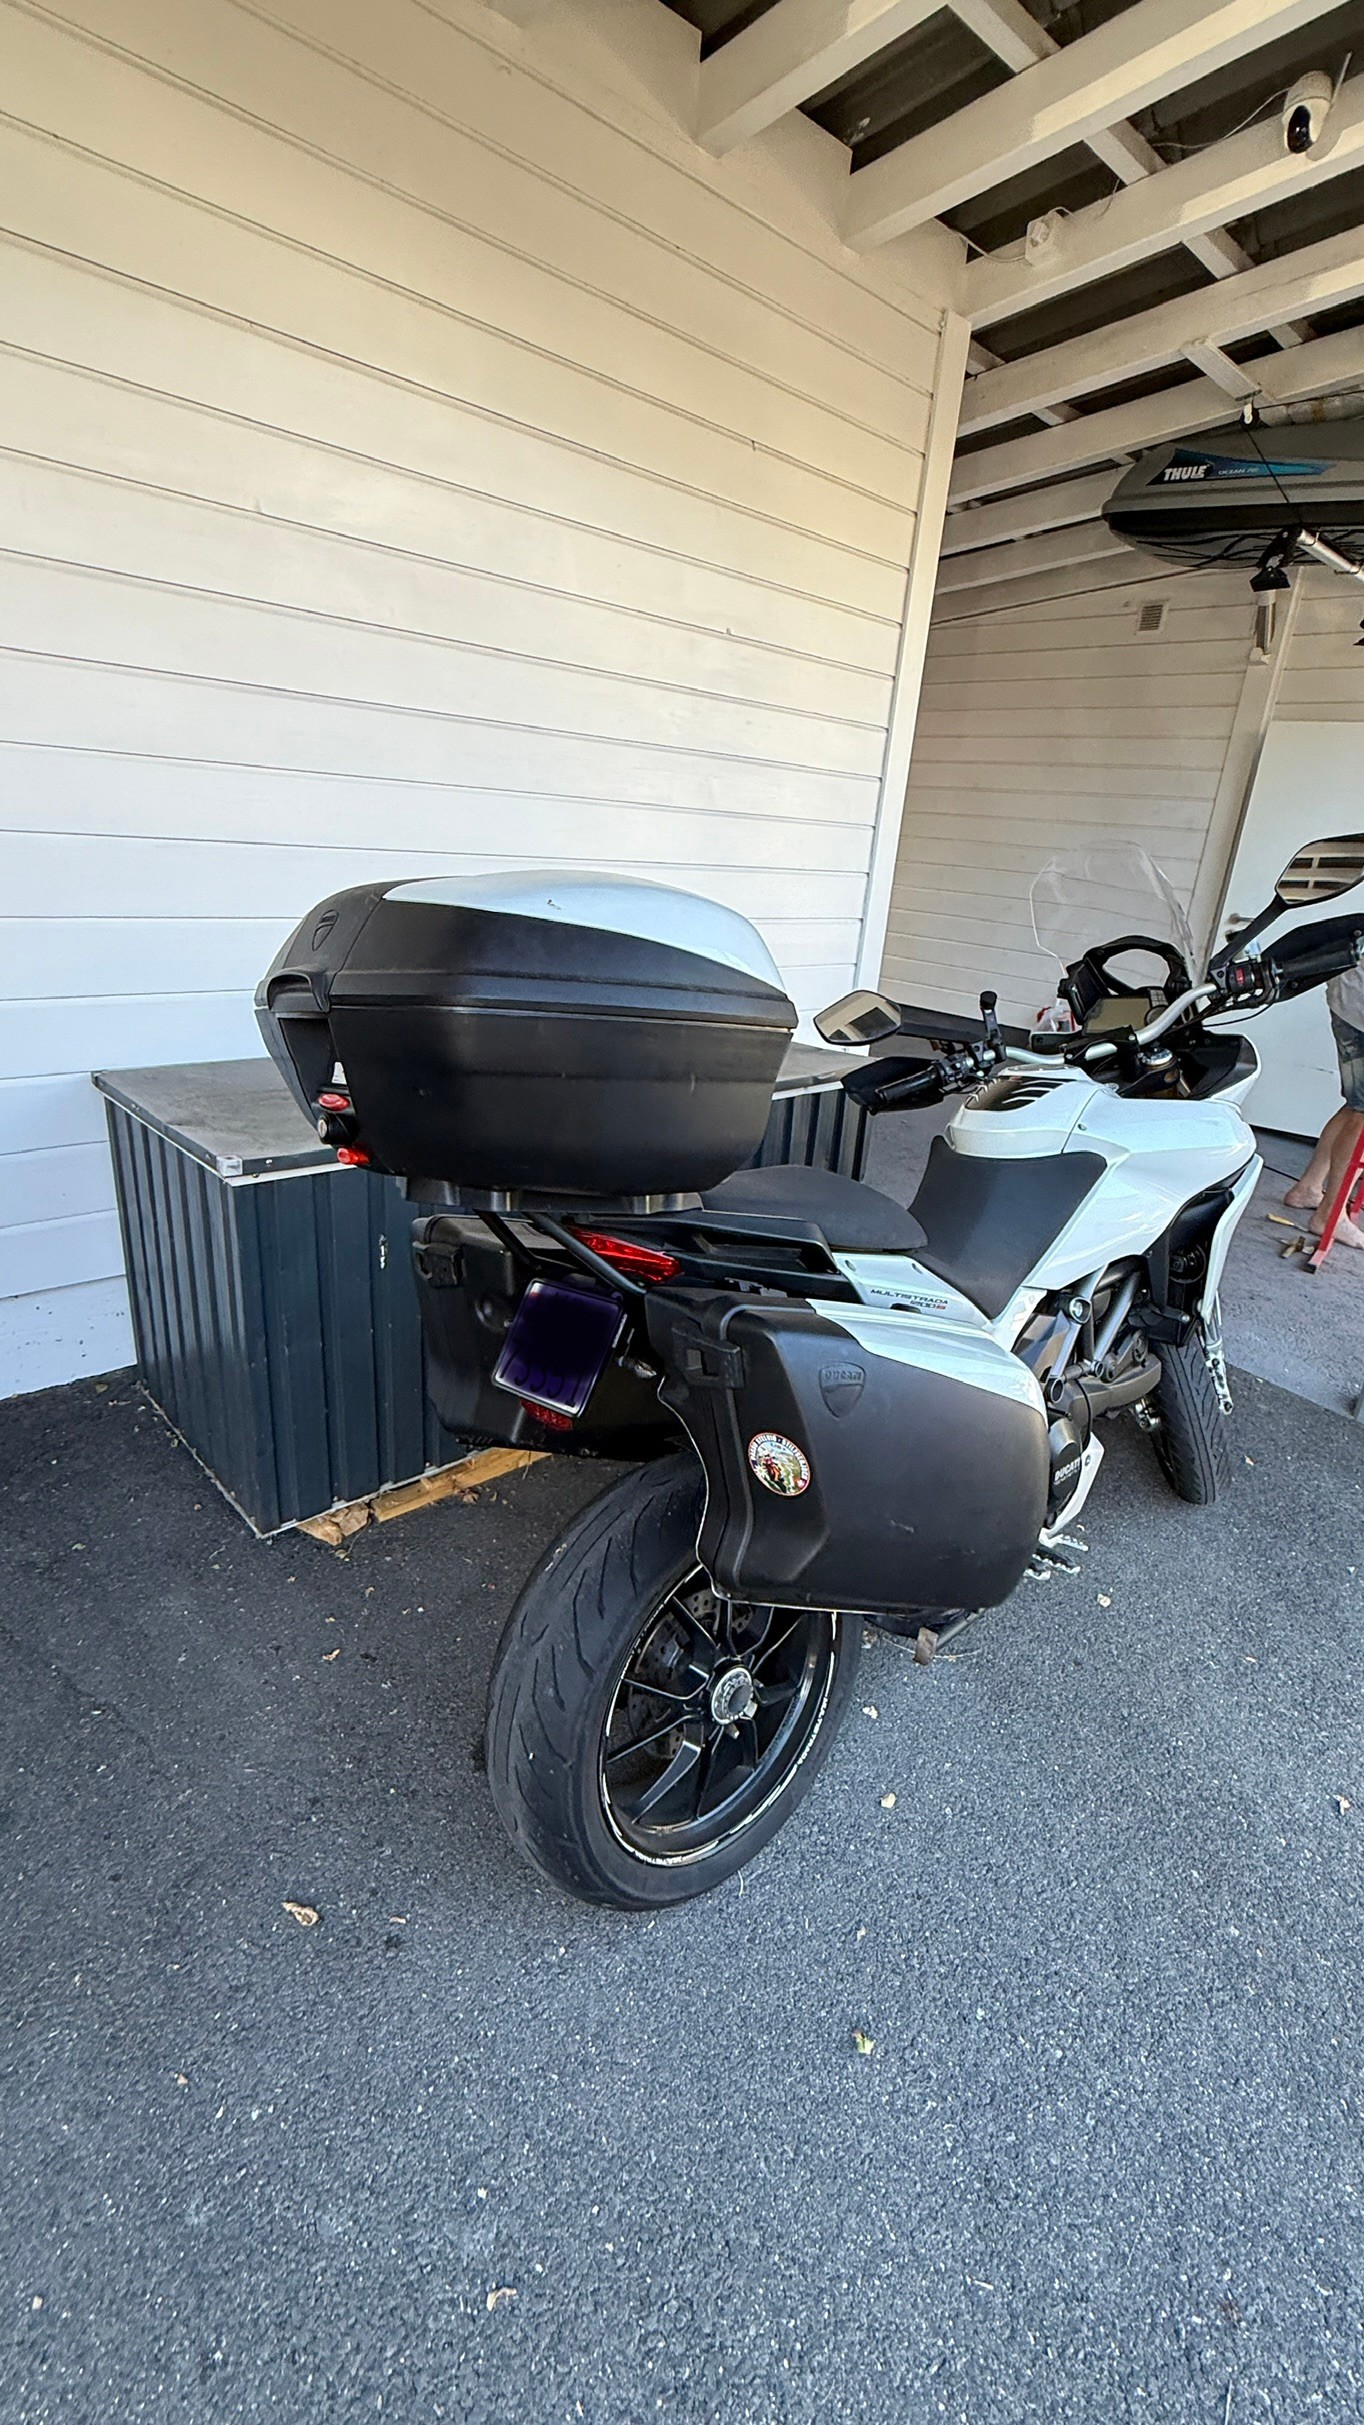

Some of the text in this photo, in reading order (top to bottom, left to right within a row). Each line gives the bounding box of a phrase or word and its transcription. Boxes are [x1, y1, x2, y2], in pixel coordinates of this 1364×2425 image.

[1163, 465, 1208, 481] THULE
[870, 1289, 949, 1304] MULTISTRADA
[825, 1370, 862, 1381] DUCATI
[1054, 1457, 1081, 1482] DUCATI
